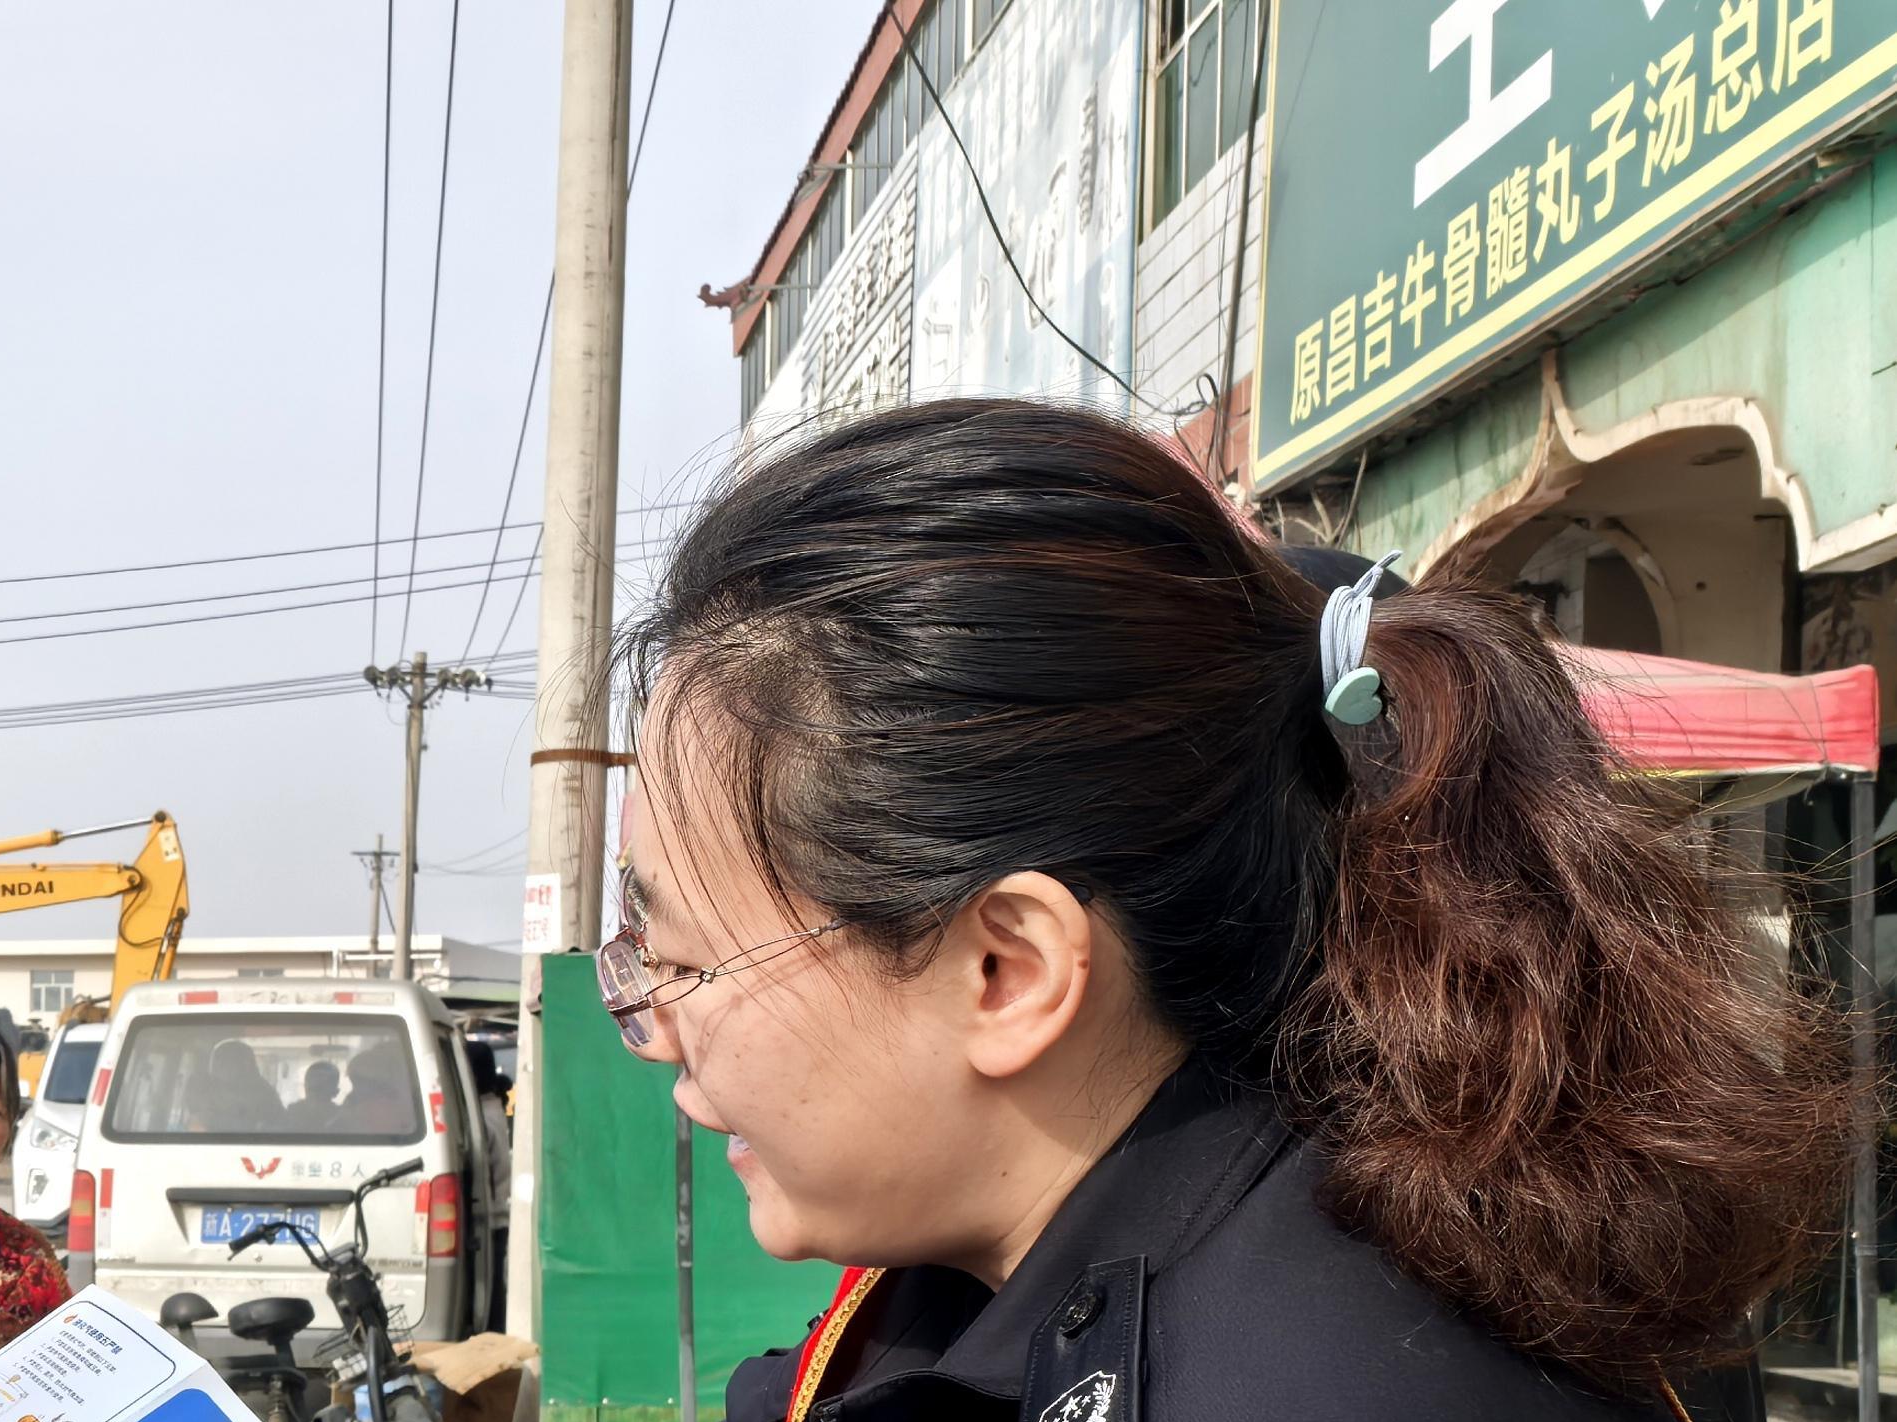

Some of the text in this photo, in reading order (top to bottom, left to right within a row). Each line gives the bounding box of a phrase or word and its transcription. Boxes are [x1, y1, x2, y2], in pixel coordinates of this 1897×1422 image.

[1290, 0, 1832, 426] 原昌吉牛骨髓丸子汤总店
